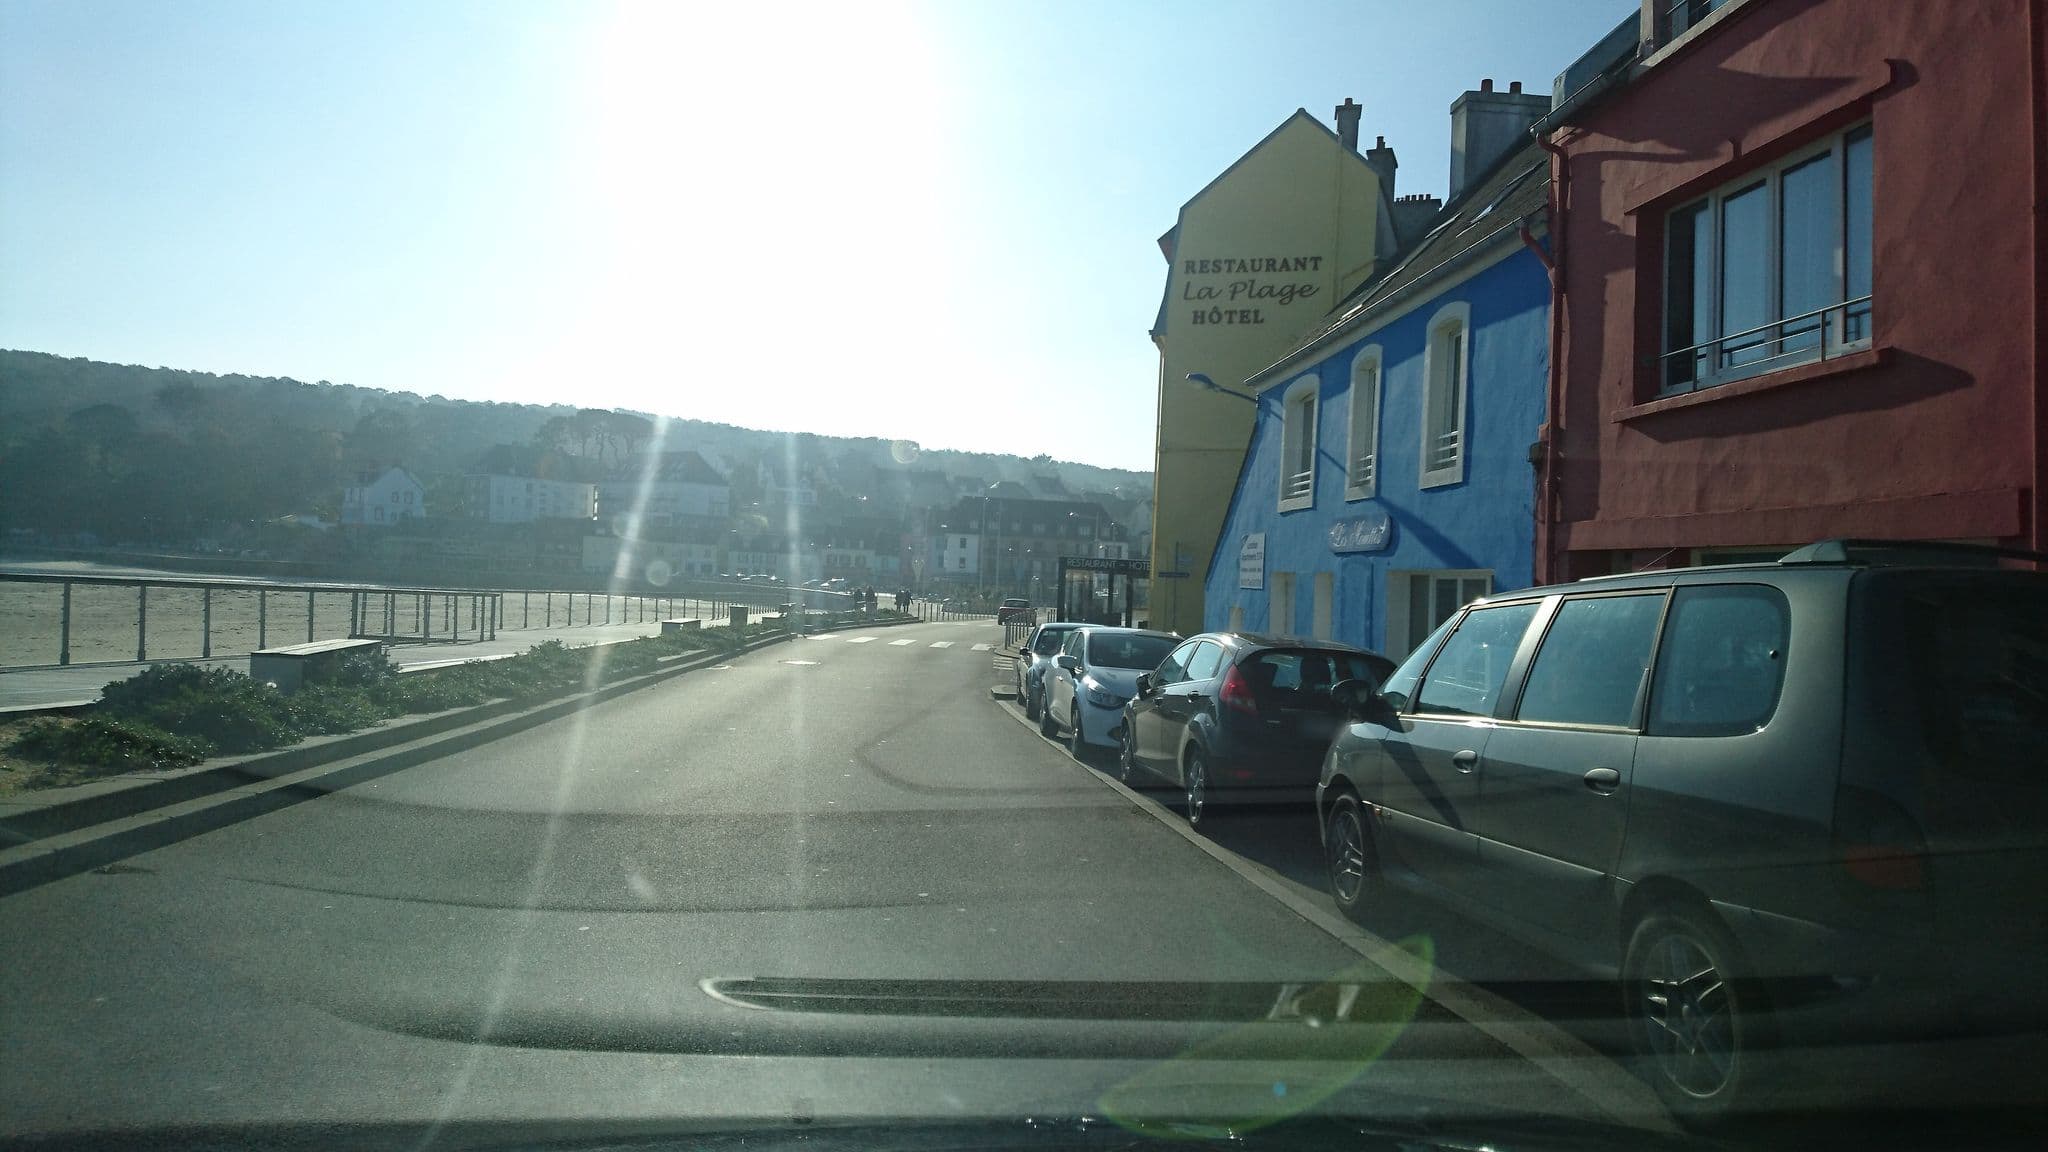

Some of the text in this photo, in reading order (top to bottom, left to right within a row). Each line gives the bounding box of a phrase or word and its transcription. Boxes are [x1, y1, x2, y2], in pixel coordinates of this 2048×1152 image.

[1184, 256, 1322, 275] RESTAURANT
[1183, 280, 1320, 306] La Plage
[1192, 306, 1265, 325] HÔTEL
[1067, 558, 1116, 569] RESTAURANT
[1129, 560, 1151, 571] HOTE
